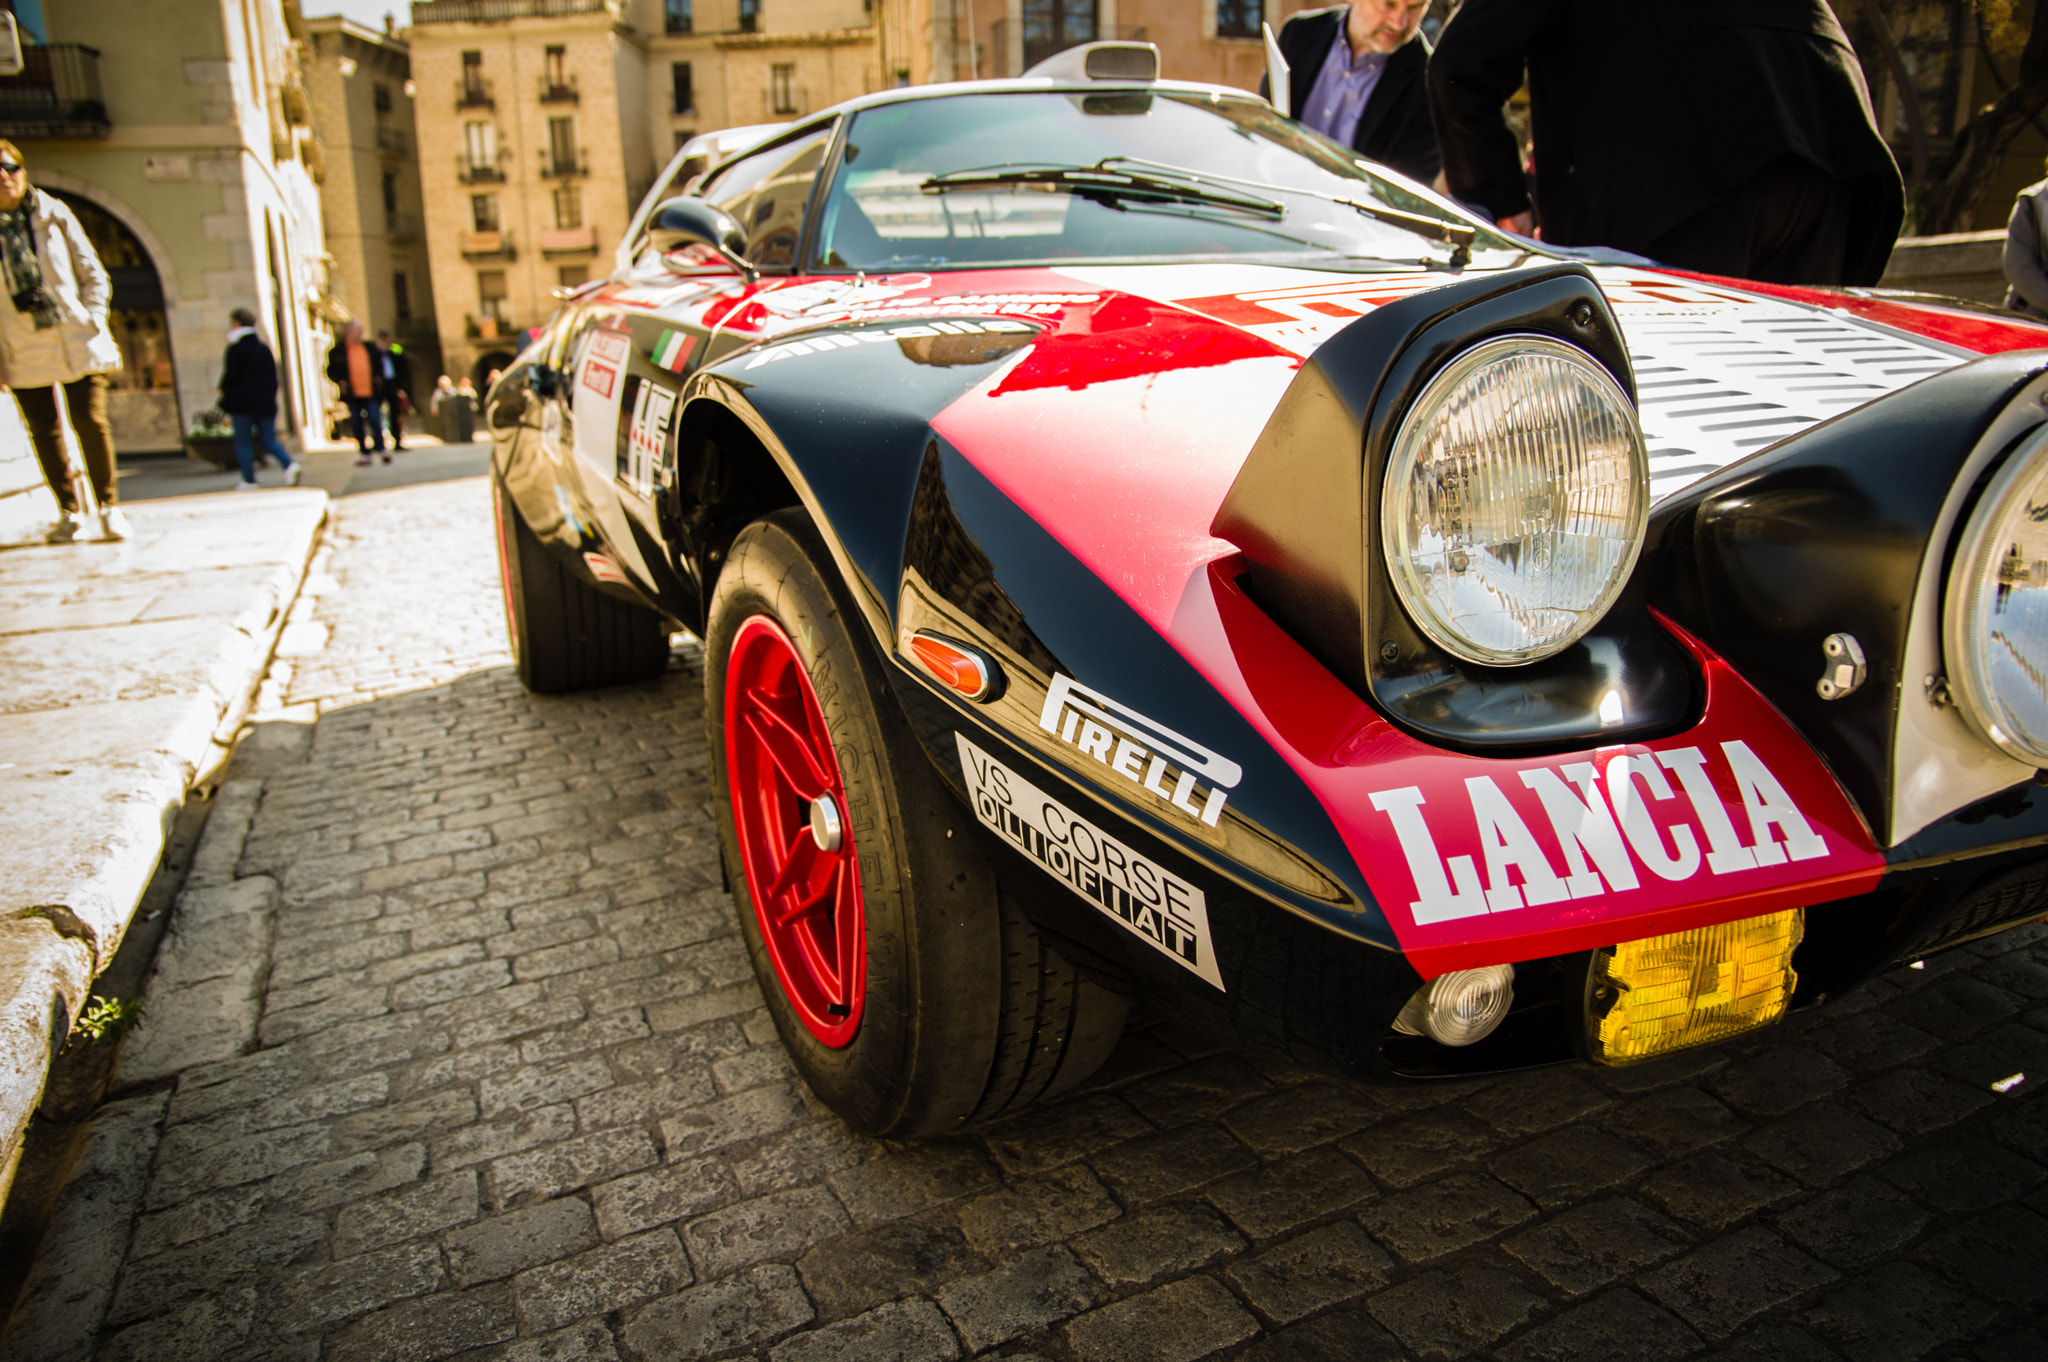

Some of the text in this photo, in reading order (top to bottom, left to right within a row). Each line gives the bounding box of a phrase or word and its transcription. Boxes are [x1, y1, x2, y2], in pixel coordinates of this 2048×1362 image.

[967, 745, 1197, 932] VS CORSE
[1039, 671, 1243, 828] PIRELLI
[1368, 740, 1830, 925] LANCIA
